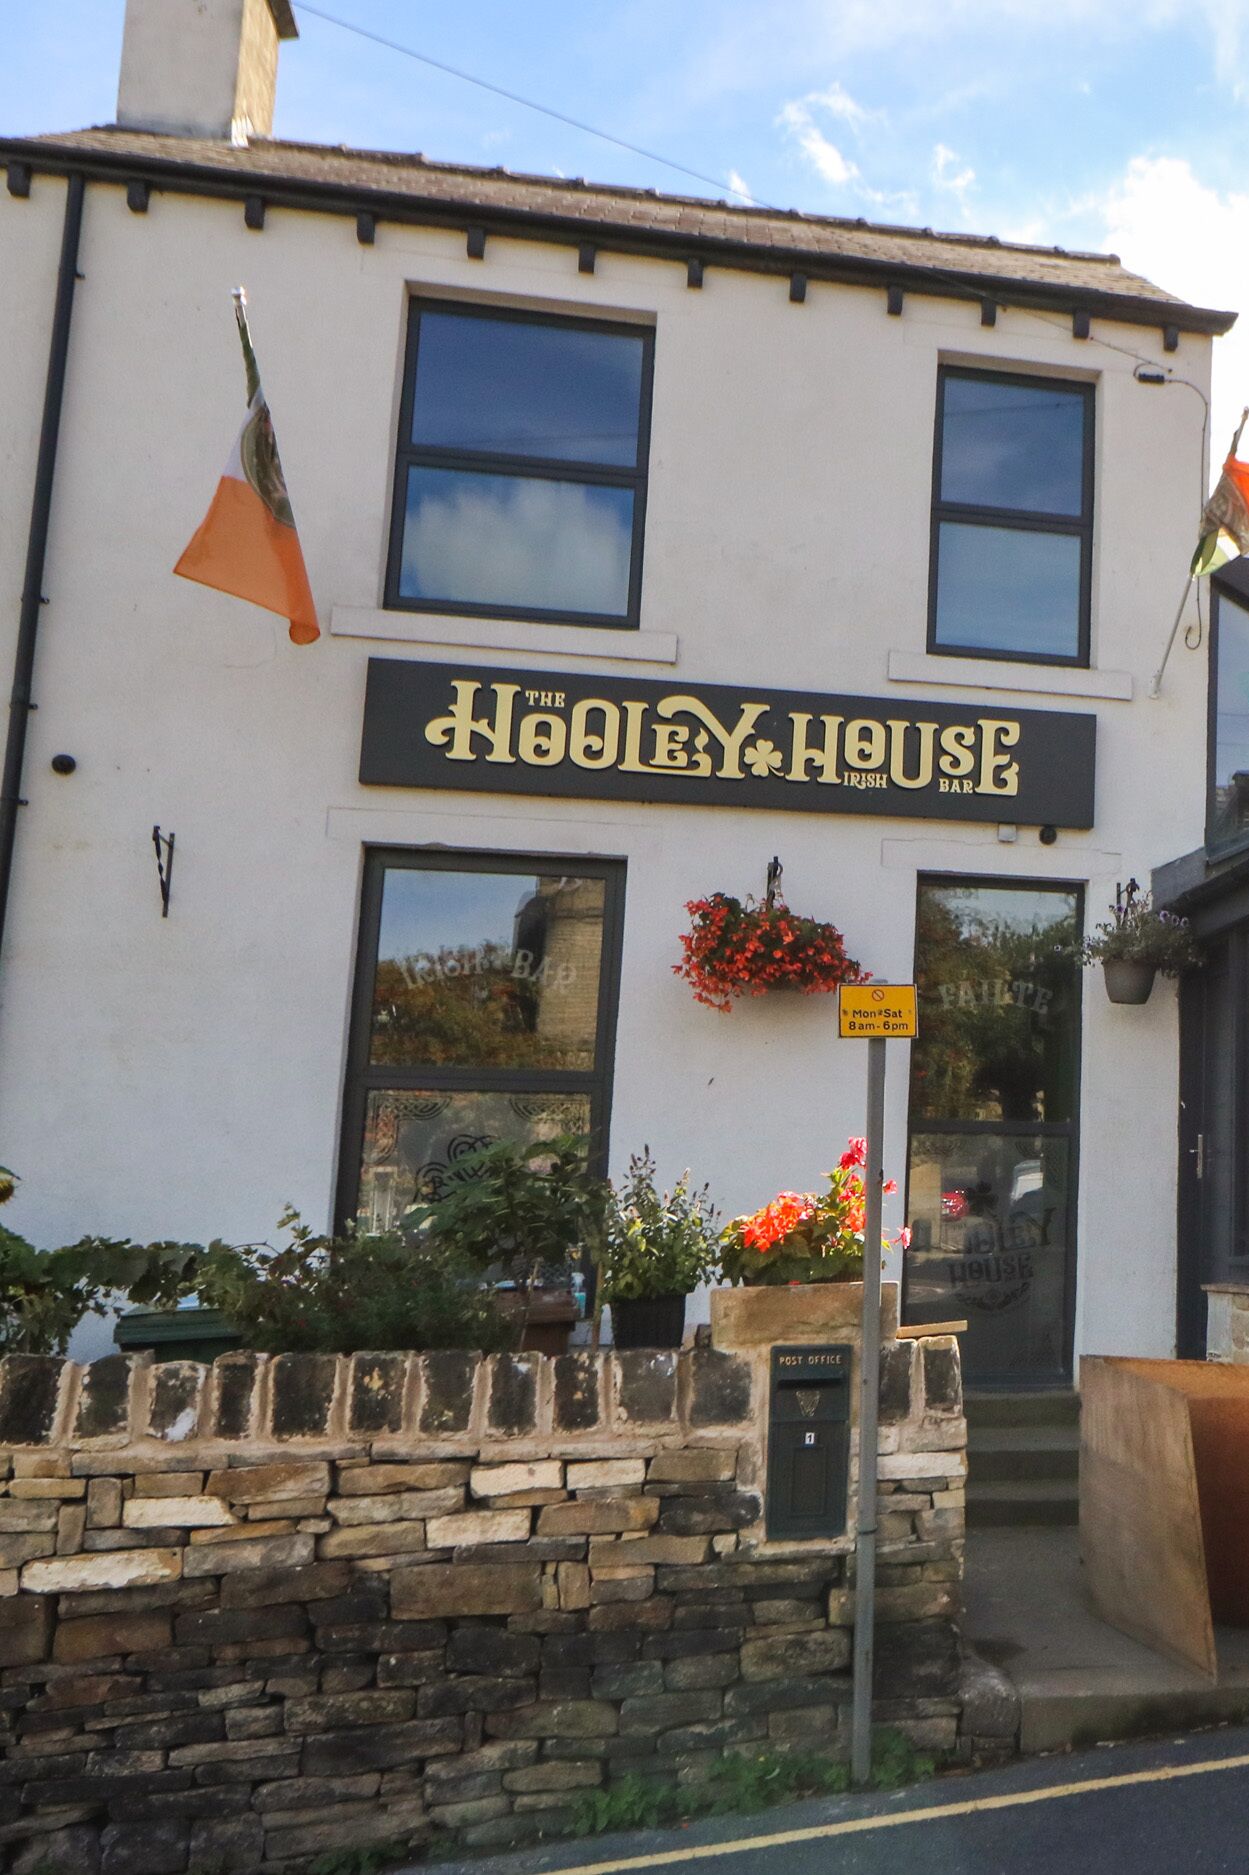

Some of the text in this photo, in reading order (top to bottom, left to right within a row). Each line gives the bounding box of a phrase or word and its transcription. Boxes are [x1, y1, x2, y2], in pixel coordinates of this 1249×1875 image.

[525, 689, 567, 708] THE
[424, 678, 1021, 797] HOOLEY HOUSE
[842, 769, 976, 795] IRISH BAR
[779, 1355, 842, 1366] POST OFFICE
